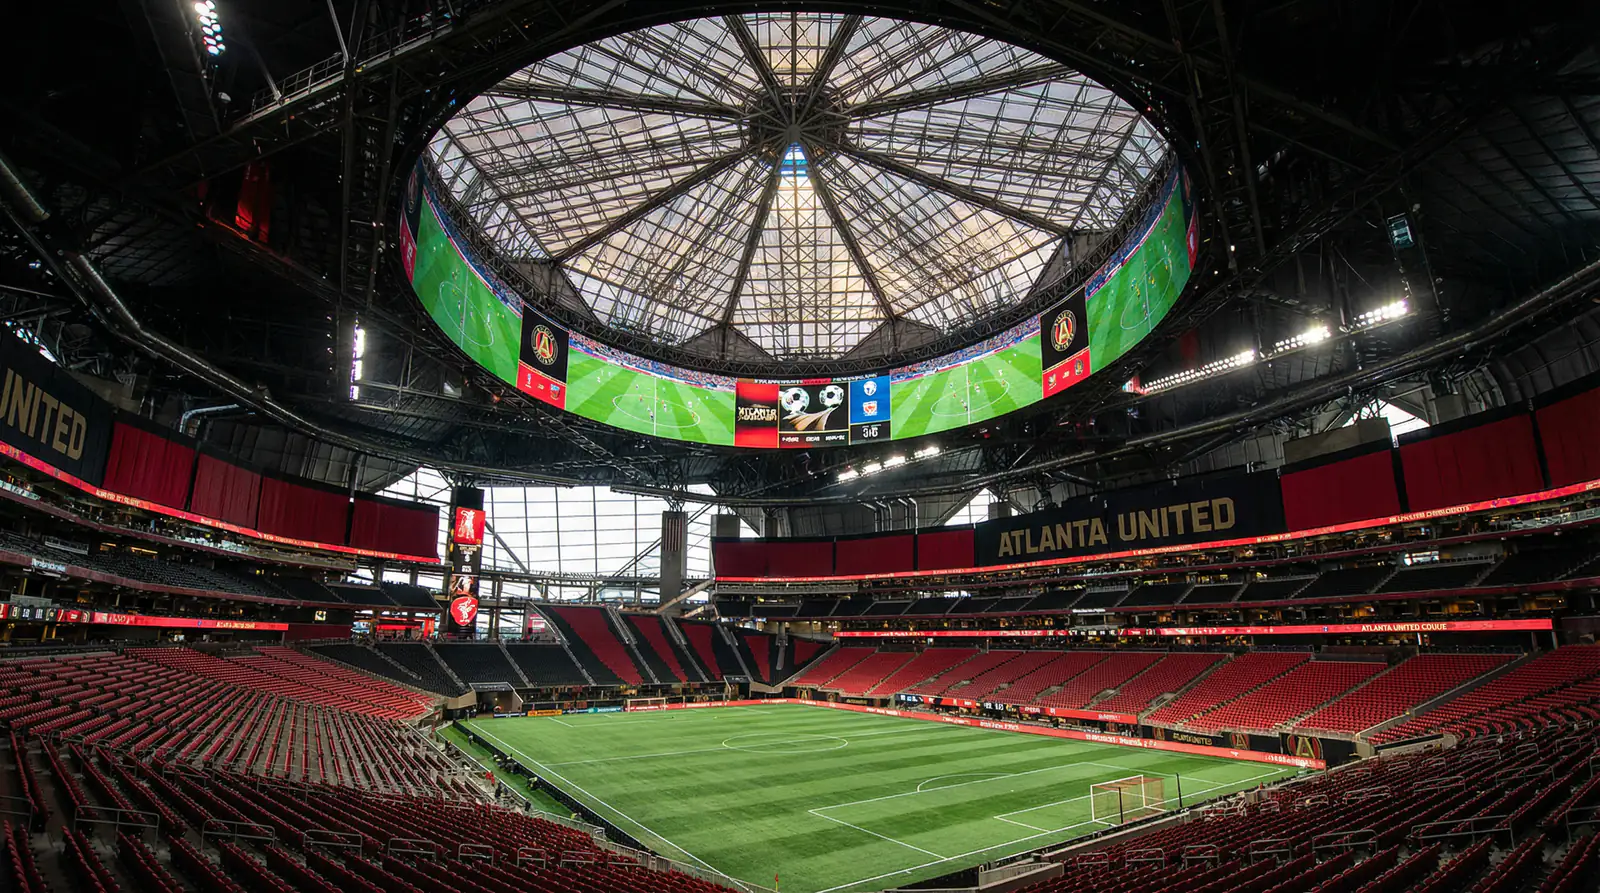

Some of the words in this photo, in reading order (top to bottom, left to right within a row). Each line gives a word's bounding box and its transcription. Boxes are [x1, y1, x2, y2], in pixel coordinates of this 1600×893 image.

[998, 517, 1109, 558] ATLANTA
[1117, 497, 1236, 542] UNITED
[1361, 624, 1392, 632] ATLANTA
